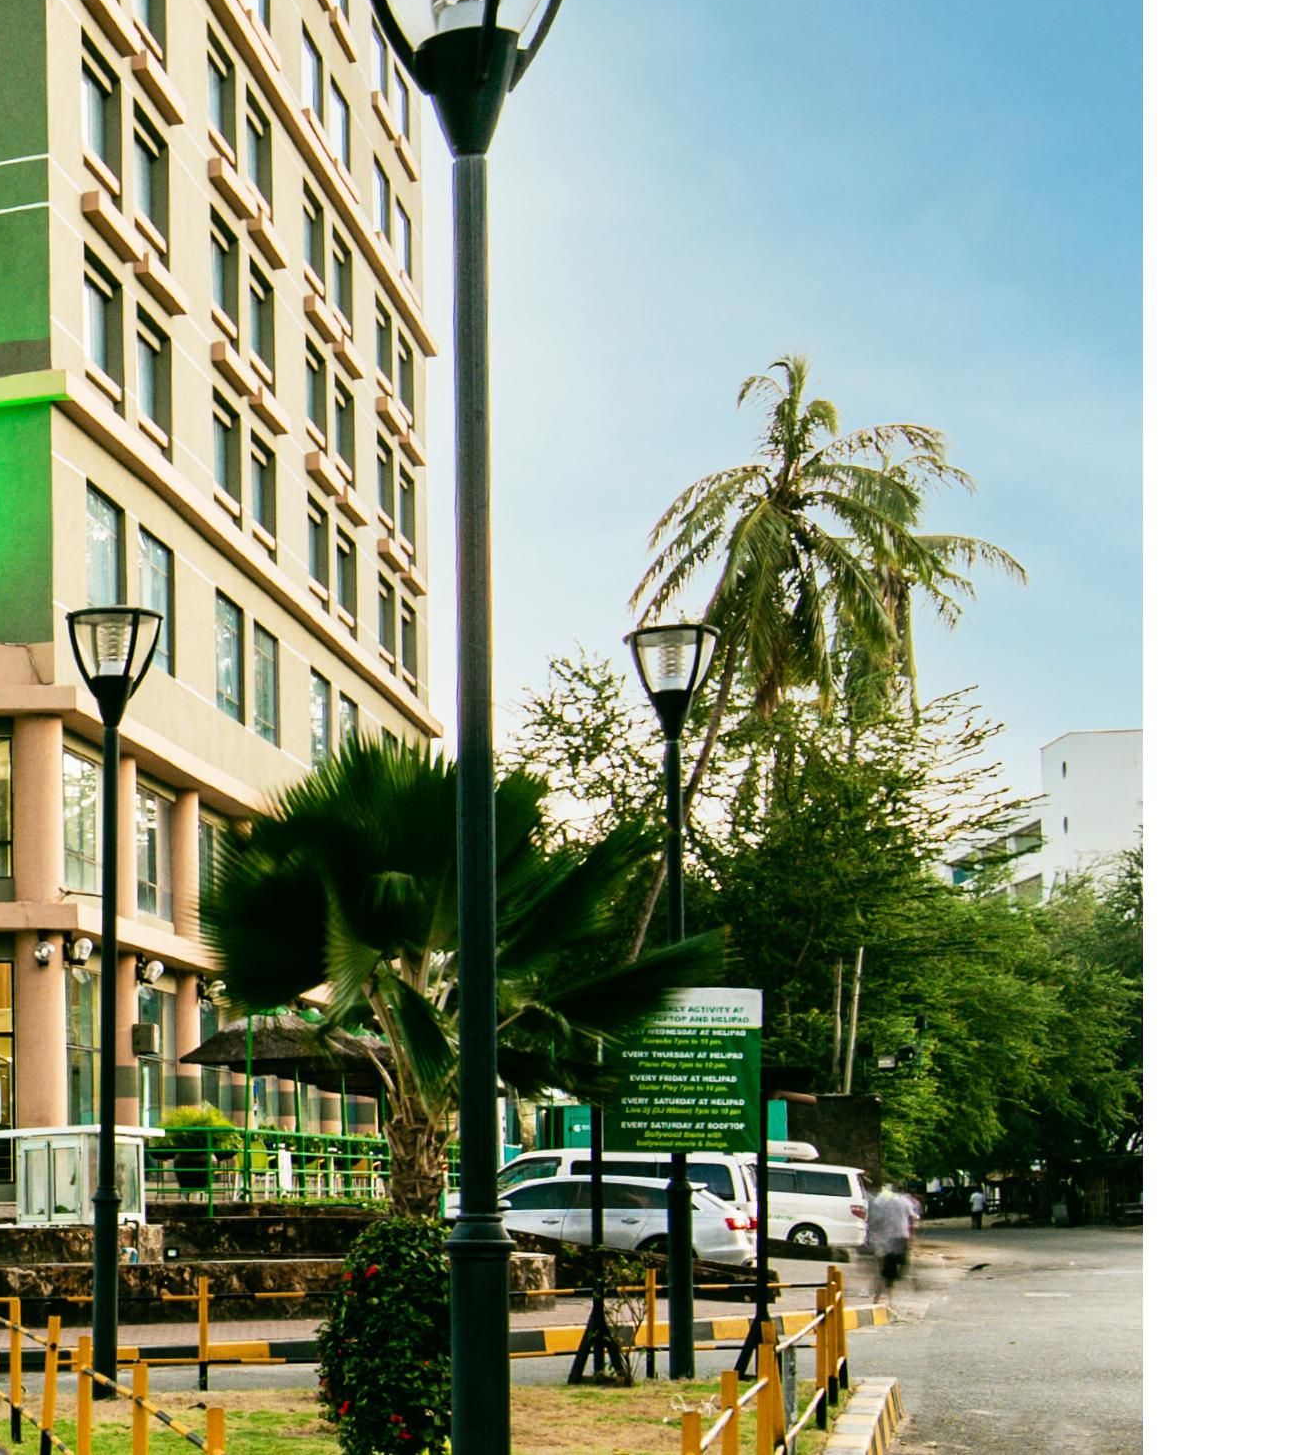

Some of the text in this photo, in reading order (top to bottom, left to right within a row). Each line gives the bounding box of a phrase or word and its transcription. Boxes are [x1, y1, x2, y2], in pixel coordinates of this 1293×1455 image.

[702, 1075, 738, 1083] HELIPAD
[710, 1098, 745, 1106] HELIPAD
[707, 1122, 746, 1130] ROOFTOP
